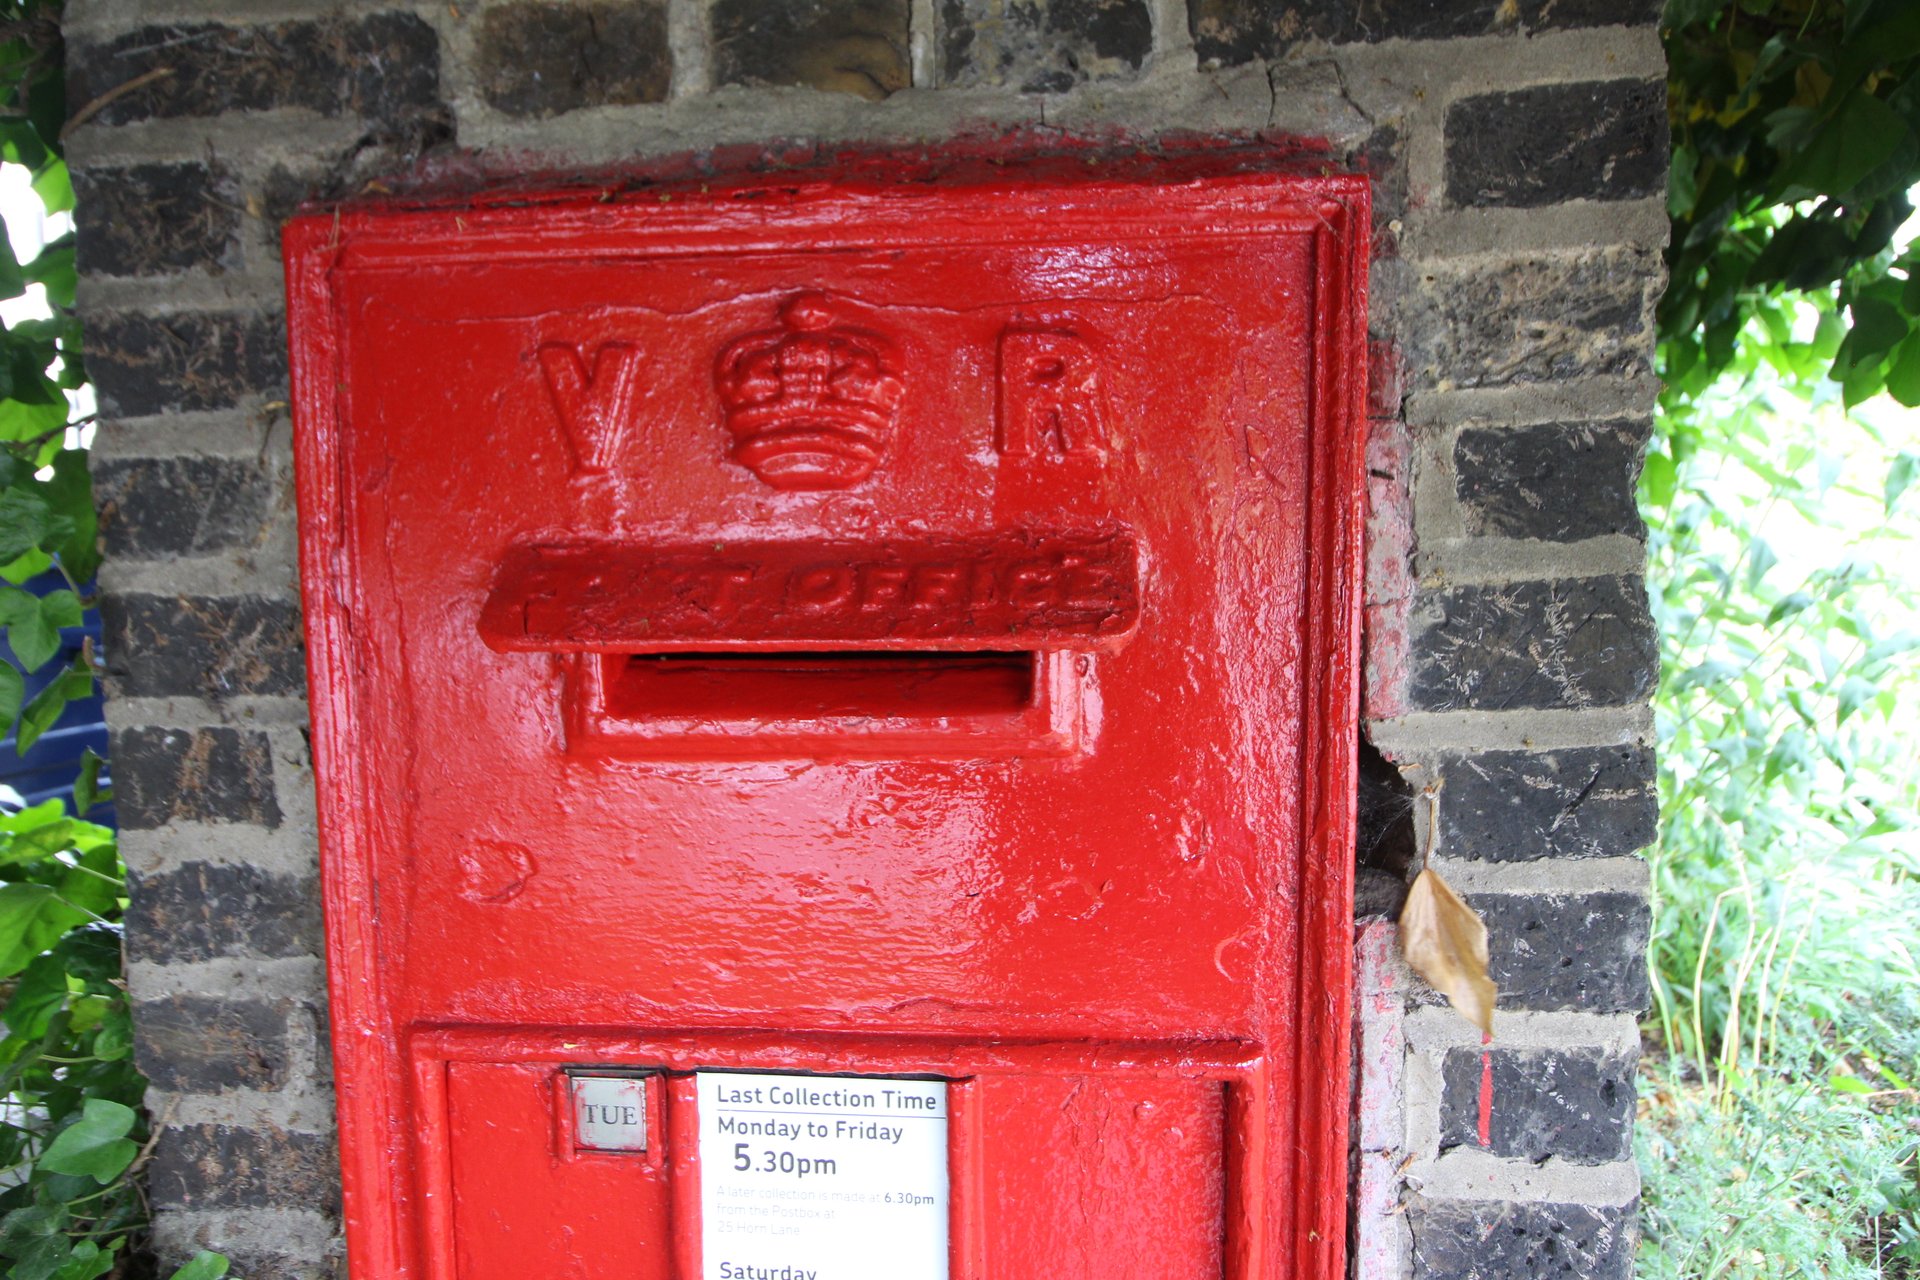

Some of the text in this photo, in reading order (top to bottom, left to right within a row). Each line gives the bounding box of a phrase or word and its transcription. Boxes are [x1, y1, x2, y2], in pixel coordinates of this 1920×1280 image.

[996, 318, 1102, 458] R
[717, 1084, 937, 1110] Last Collection Time
[582, 1103, 638, 1126] TUE
[717, 1116, 904, 1144] Monday to Friday
[733, 1143, 837, 1178] 5.30pm
[716, 1185, 936, 1206] A later collection is made at 6.30pm
[716, 1203, 836, 1219] from the Postbox at
[717, 1220, 801, 1236] 25 Horn Lane
[719, 1261, 818, 1280] Saturday
